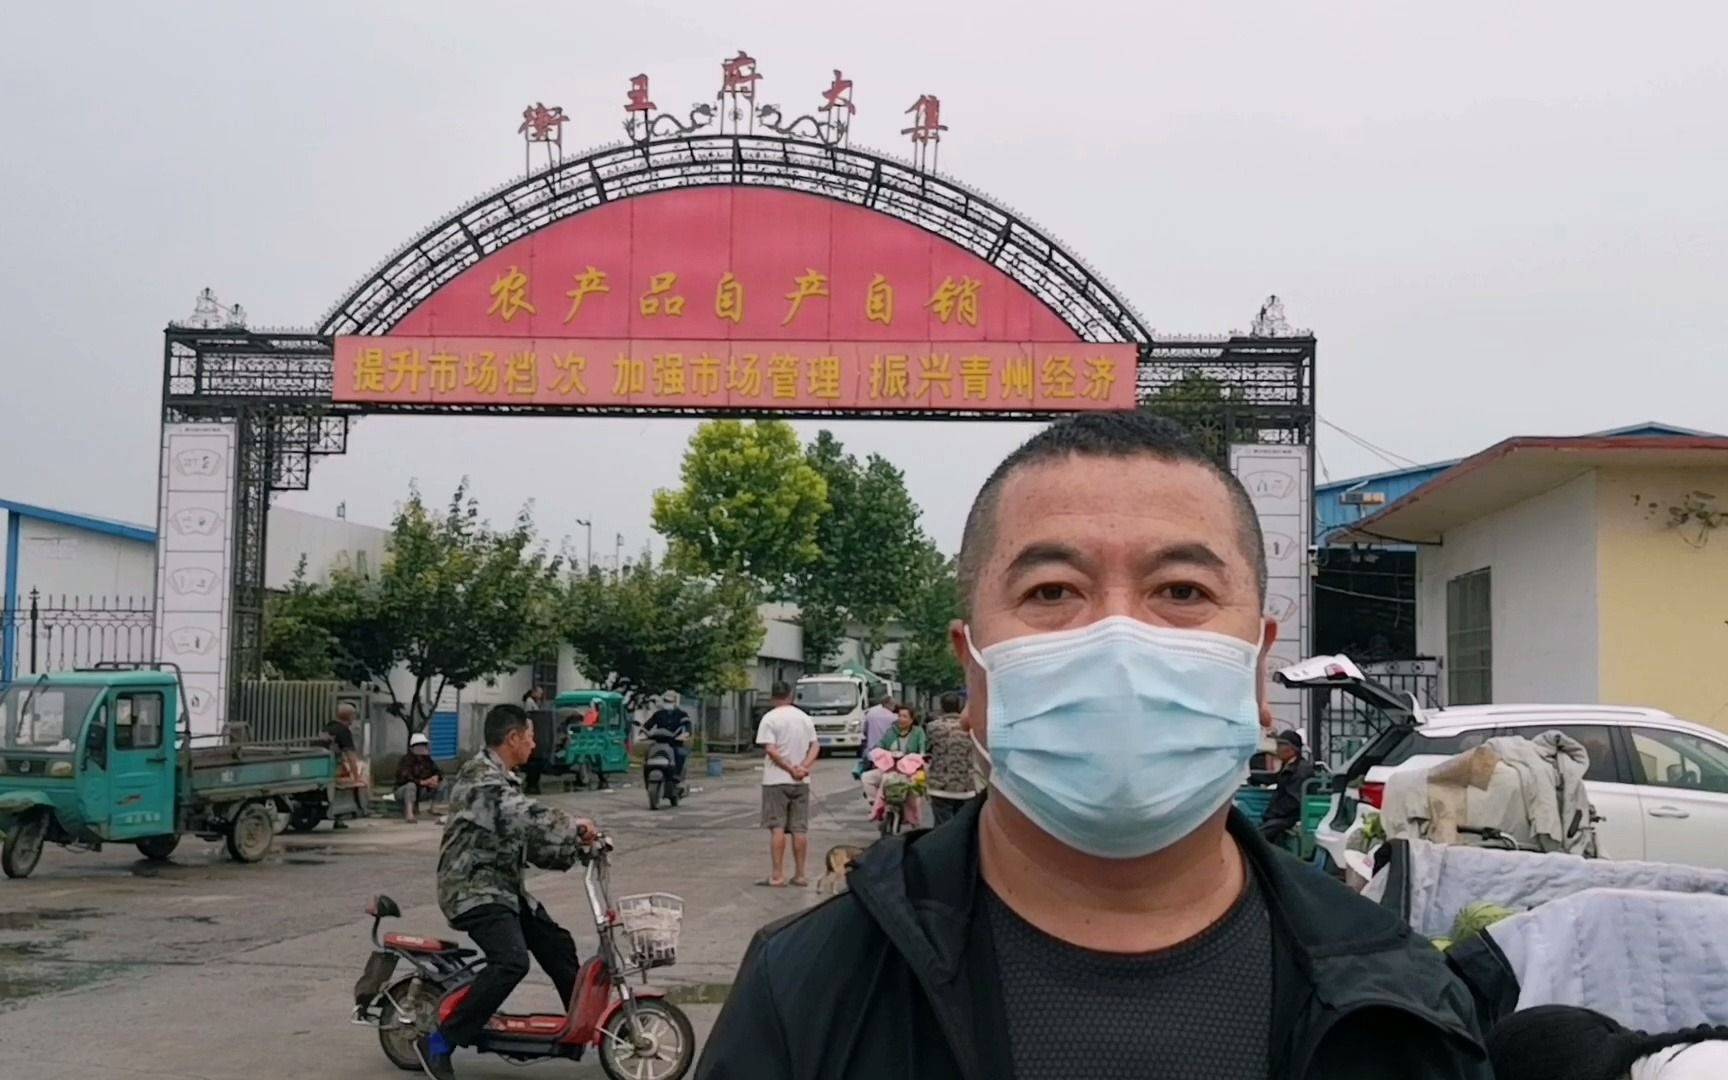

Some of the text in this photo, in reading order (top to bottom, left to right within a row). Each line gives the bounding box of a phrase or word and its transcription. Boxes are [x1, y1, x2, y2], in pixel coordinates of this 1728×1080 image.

[486, 267, 983, 326] 农产品自产自销
[352, 346, 1118, 401] 提升市场档次 加强市场管理 振兴青州经济
